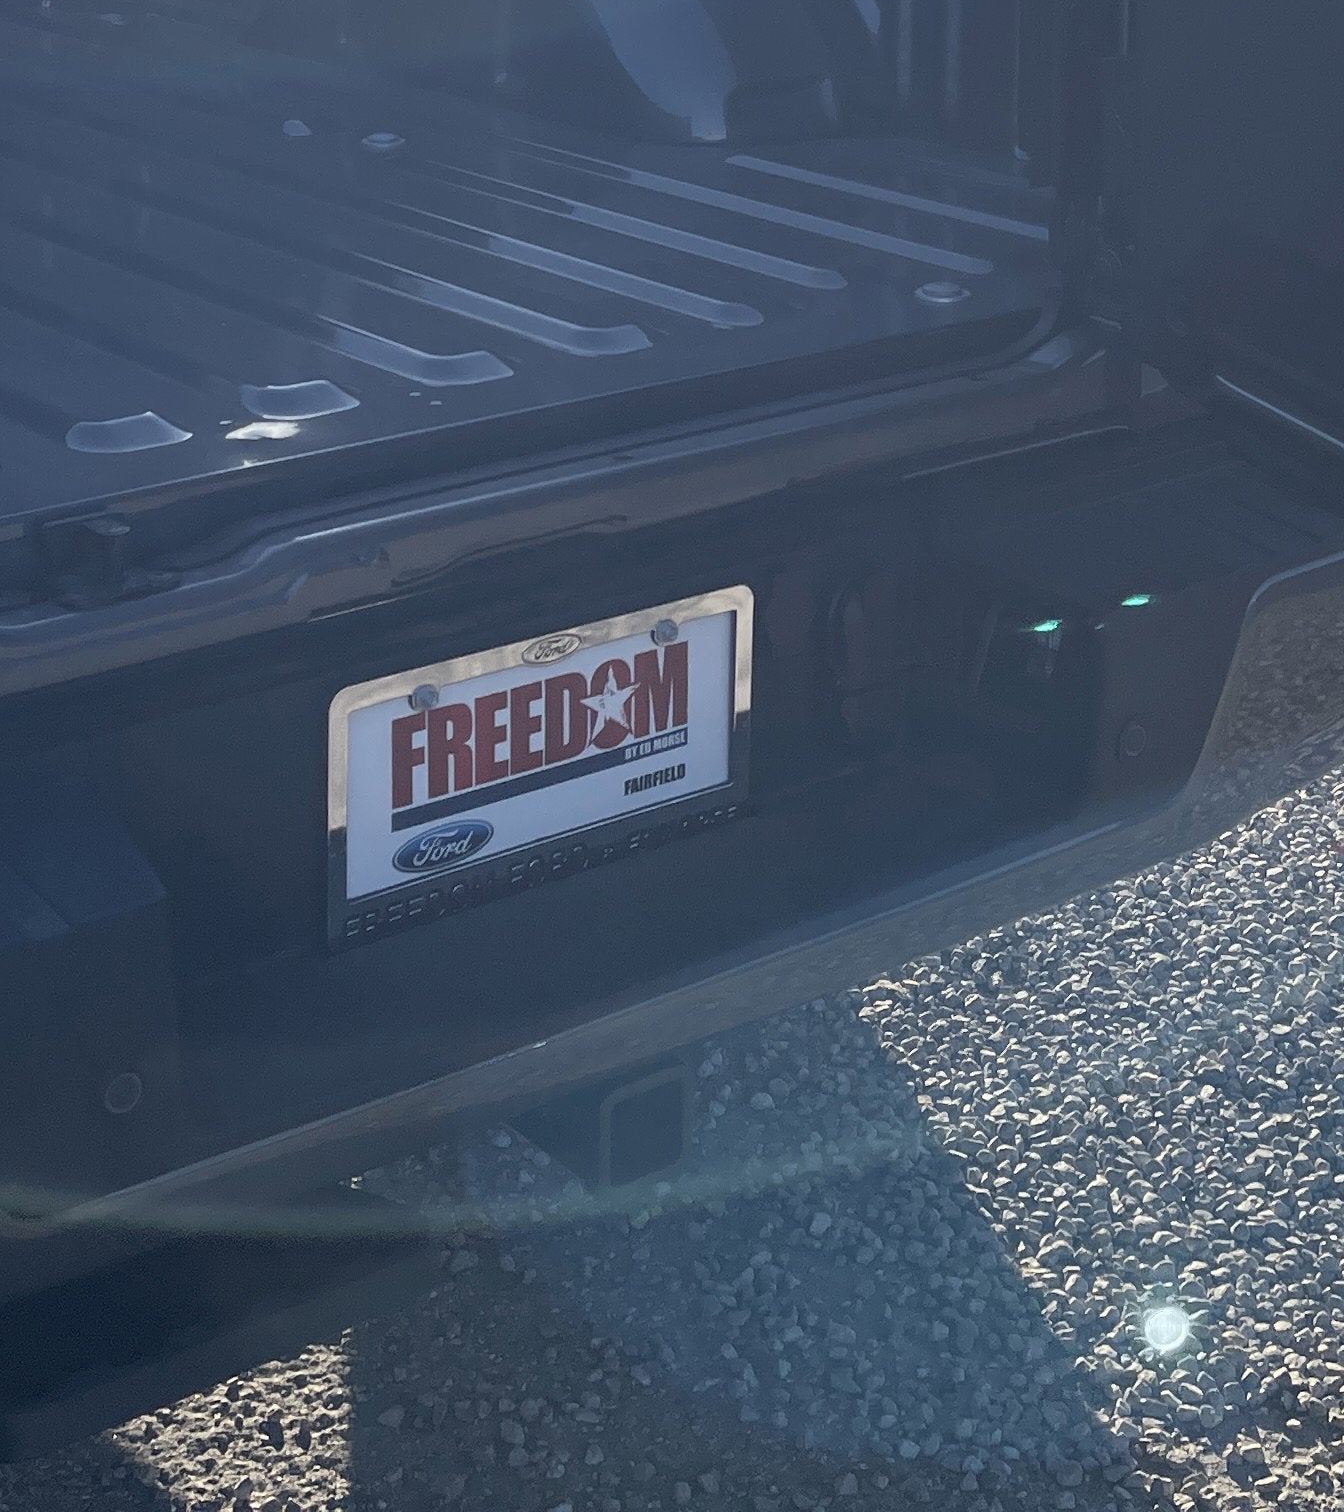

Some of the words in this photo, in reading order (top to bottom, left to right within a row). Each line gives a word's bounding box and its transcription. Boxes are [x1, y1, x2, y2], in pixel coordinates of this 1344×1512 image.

[391, 640, 689, 809] FREEDOM
[623, 763, 686, 797] FAIRFIELD
[412, 828, 475, 867] Ford
